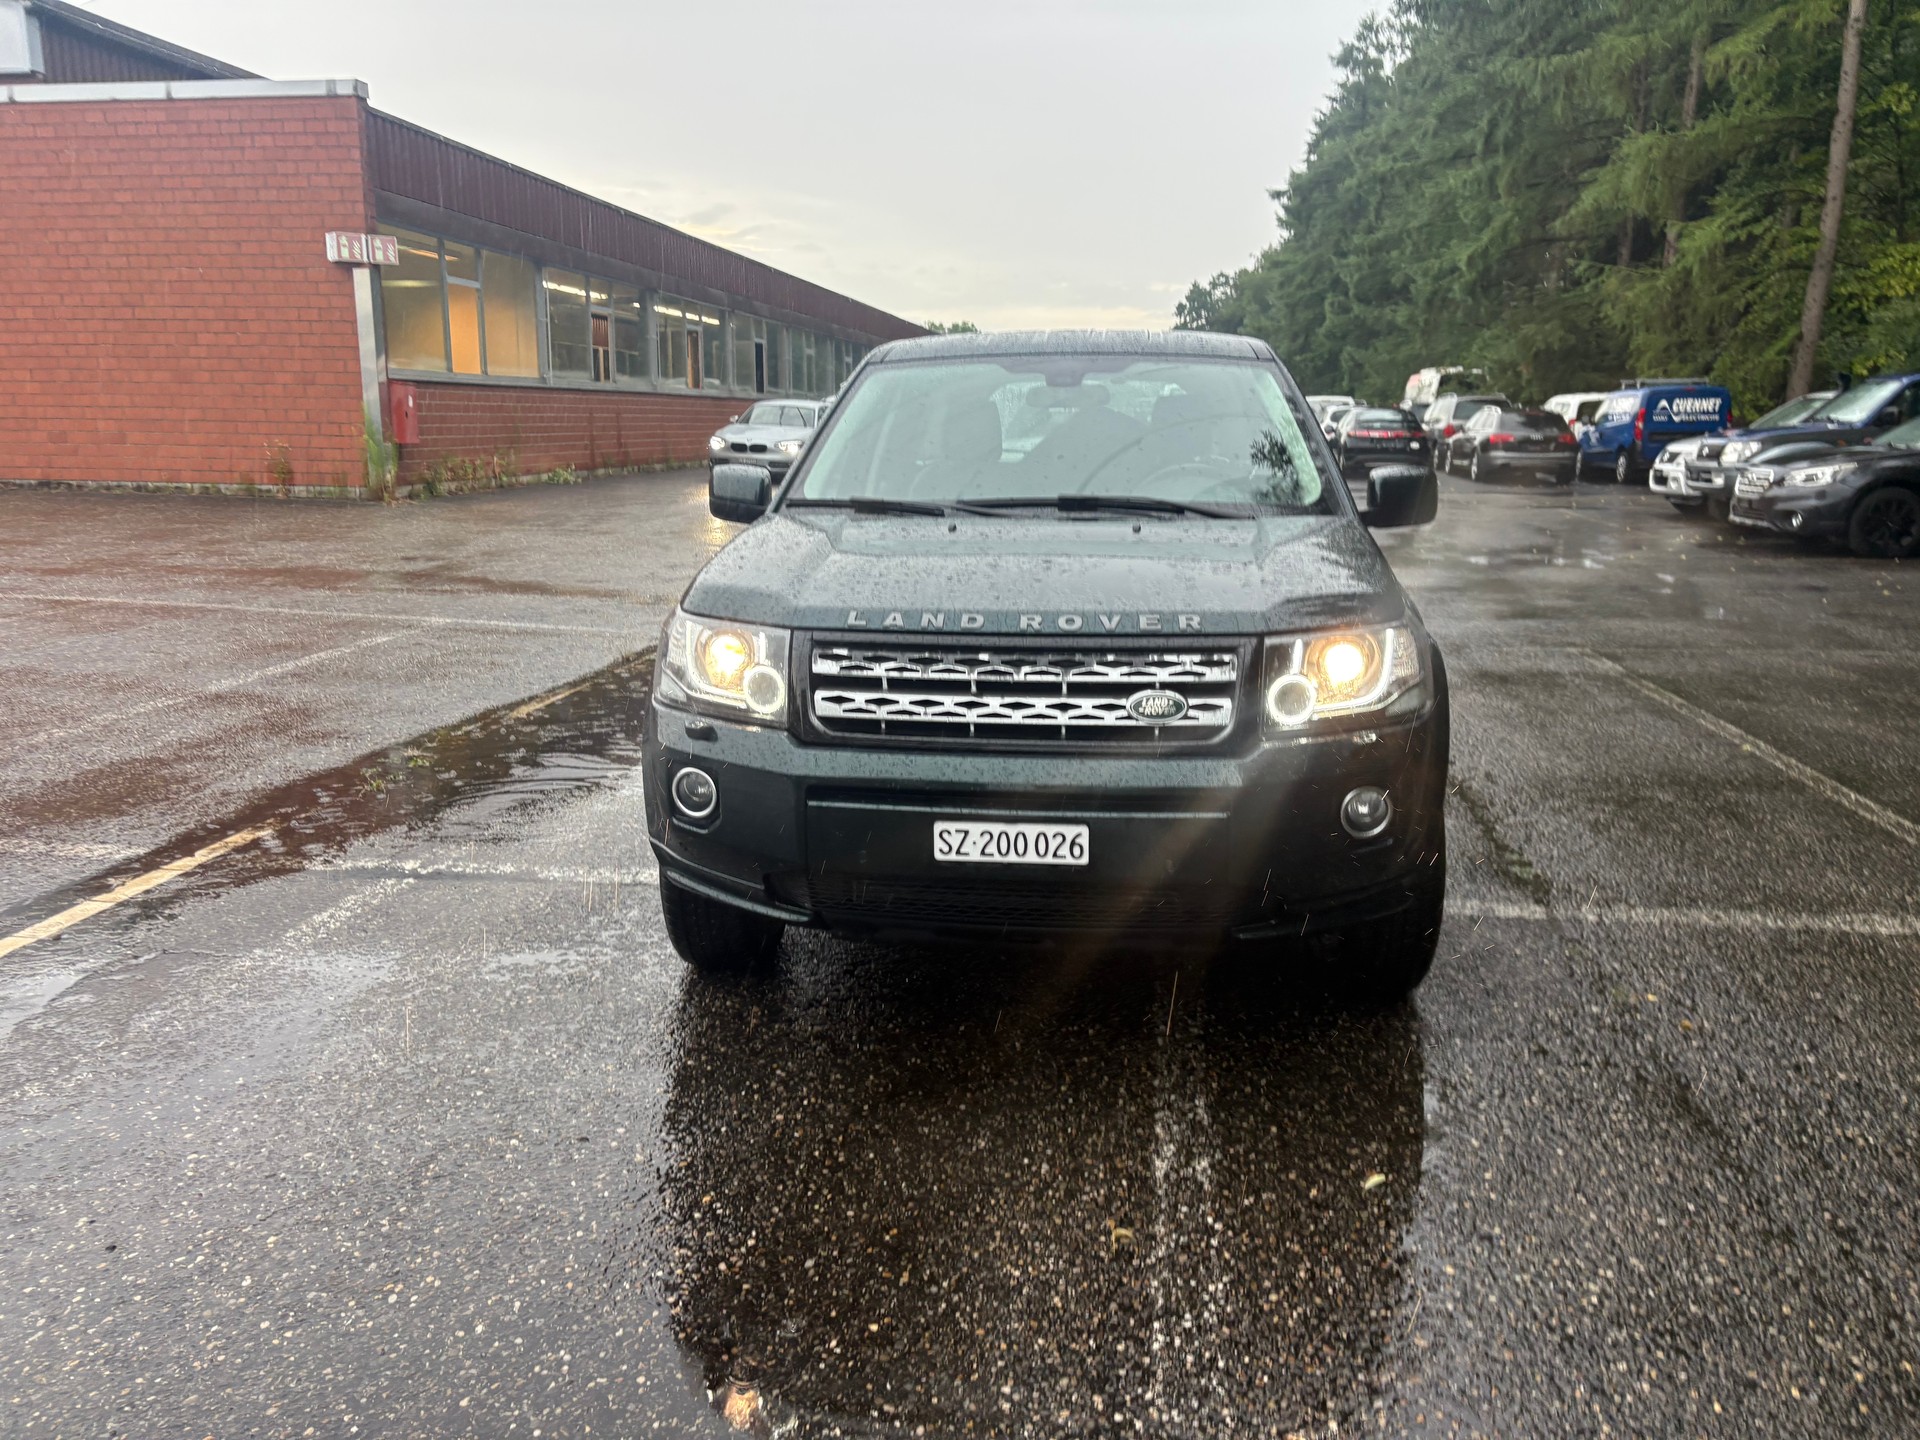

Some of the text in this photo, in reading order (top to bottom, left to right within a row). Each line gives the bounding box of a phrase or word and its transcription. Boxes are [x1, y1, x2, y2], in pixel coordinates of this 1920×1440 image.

[847, 610, 1202, 631] LAND ROVER
[1142, 696, 1168, 707] LAND
[1144, 705, 1176, 716] ROVER
